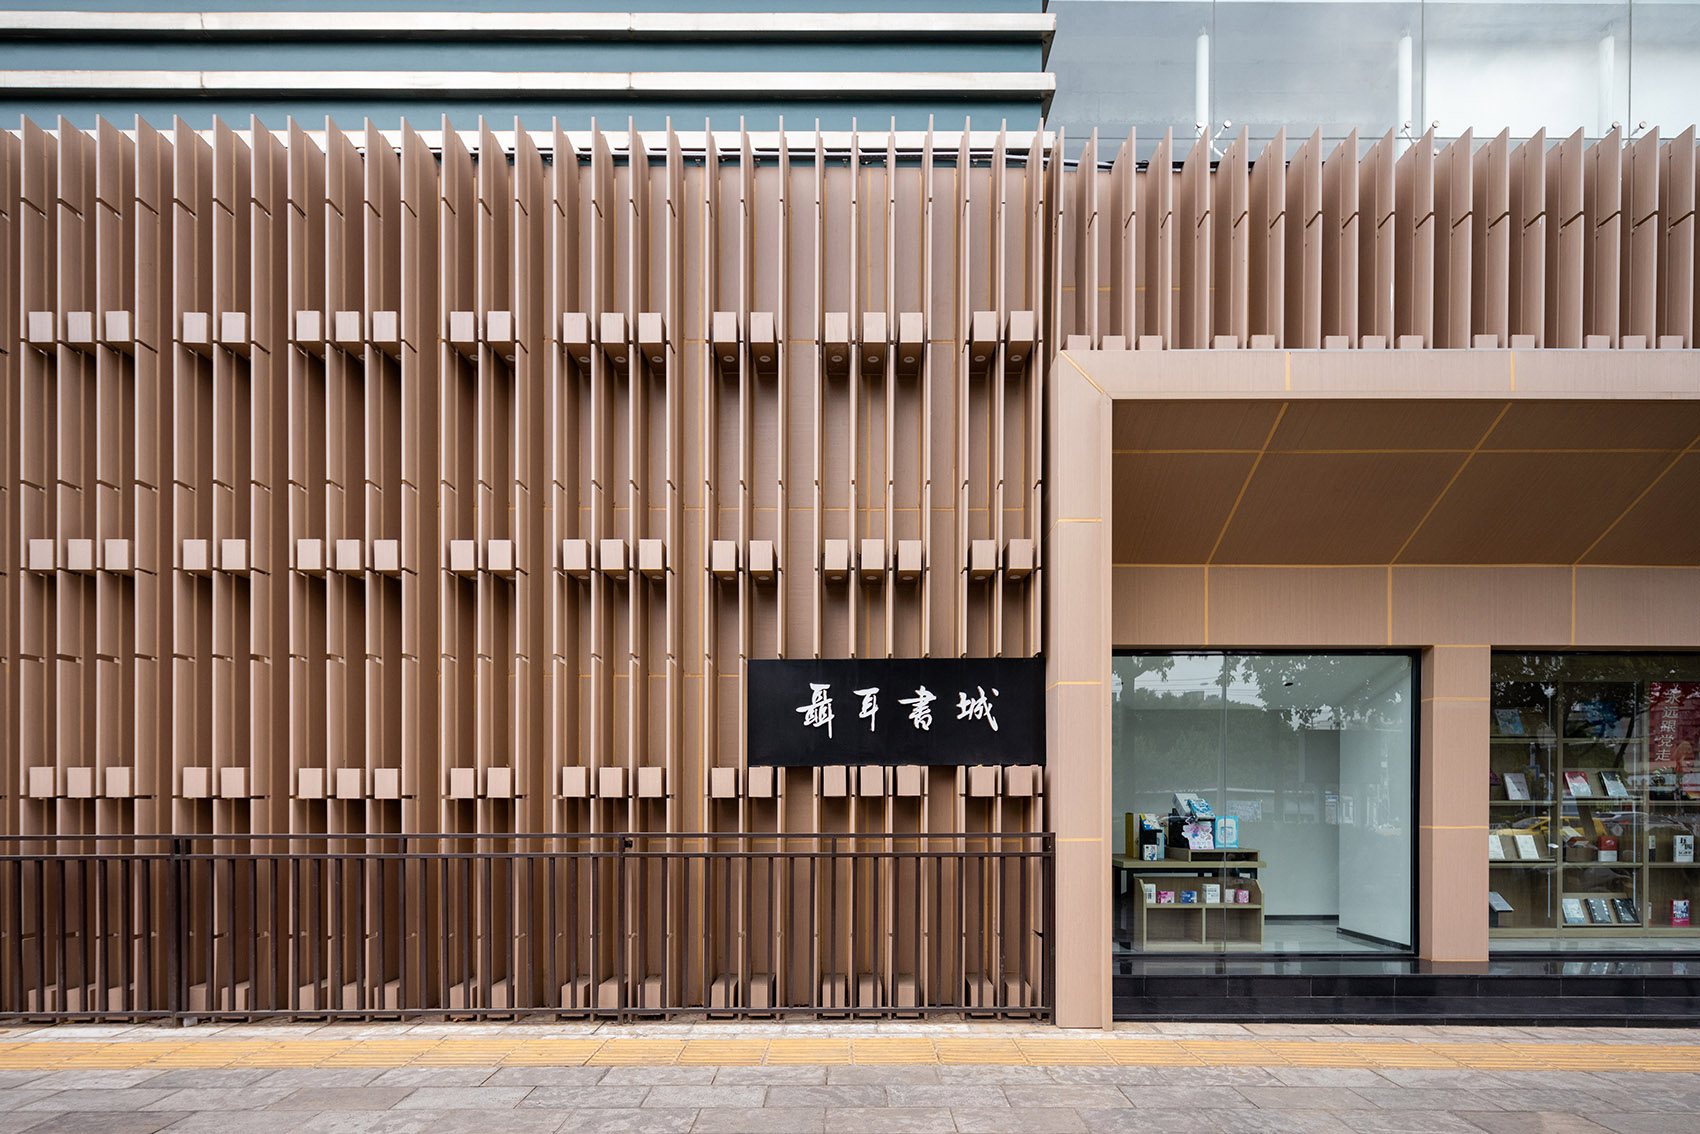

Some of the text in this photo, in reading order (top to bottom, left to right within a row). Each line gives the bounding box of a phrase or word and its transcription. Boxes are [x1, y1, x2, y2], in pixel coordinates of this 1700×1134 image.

[1655, 688, 1681, 761] 永远跟党走
